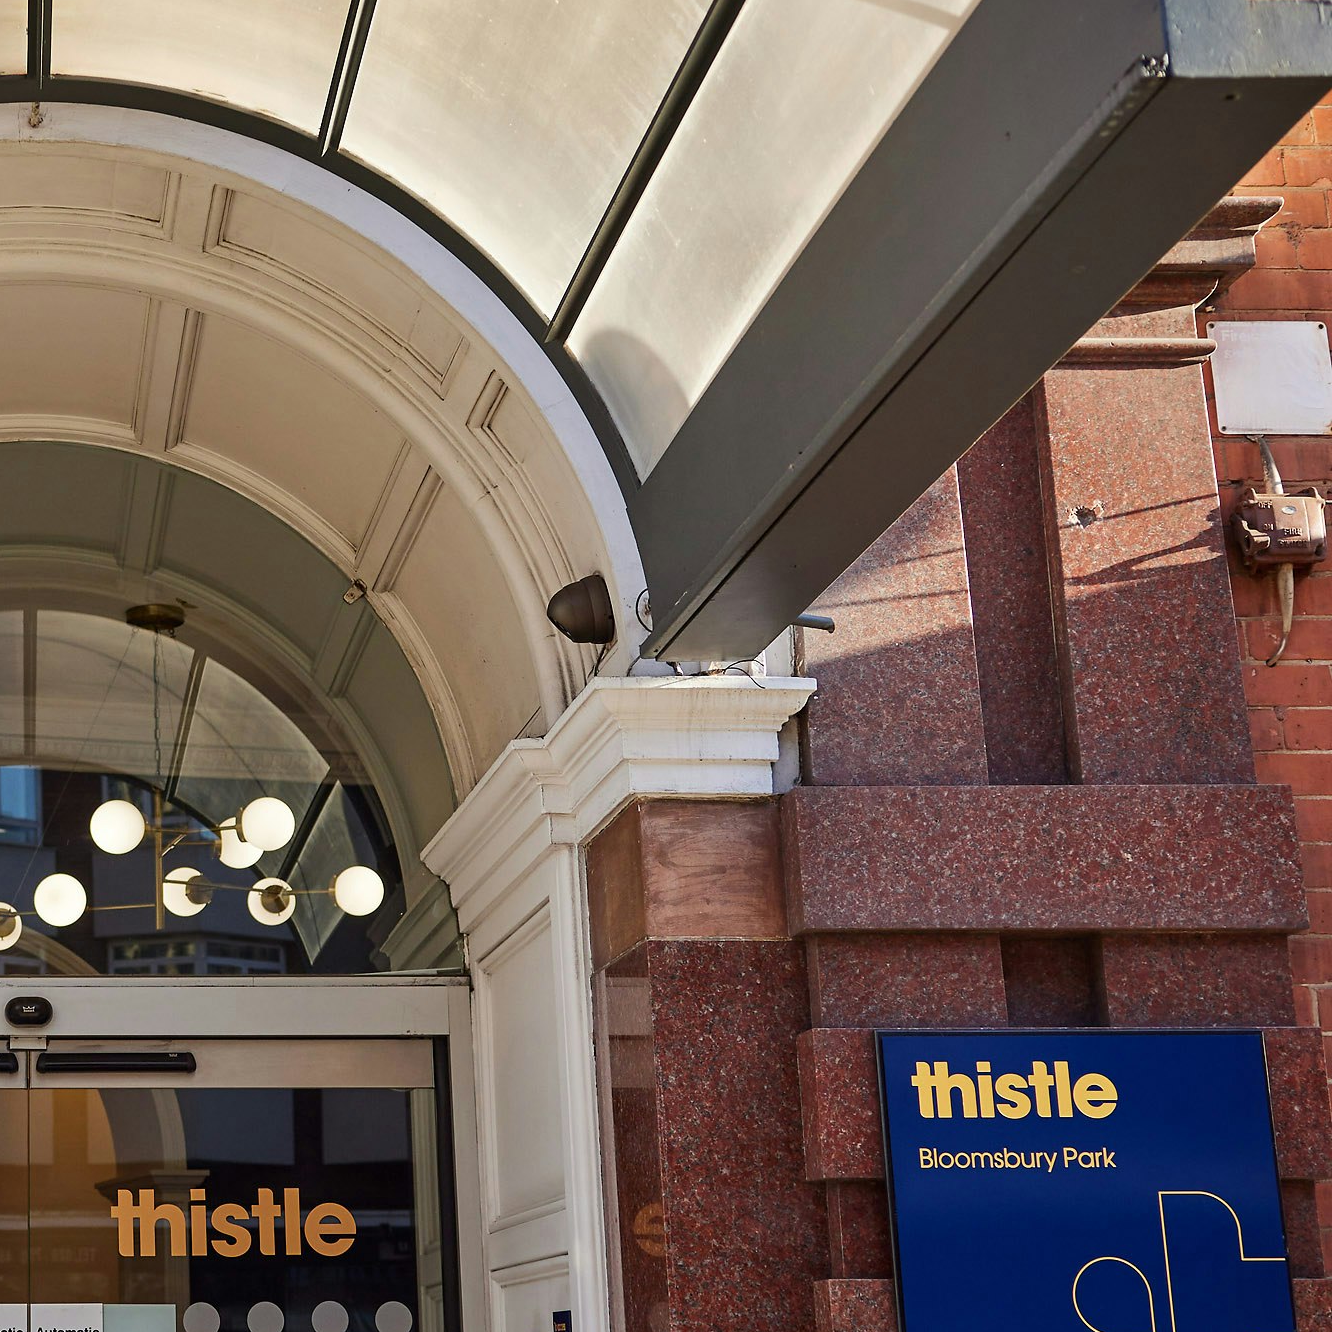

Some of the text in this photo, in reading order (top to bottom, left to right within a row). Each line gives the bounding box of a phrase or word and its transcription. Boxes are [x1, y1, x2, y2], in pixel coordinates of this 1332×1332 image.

[911, 1060, 1119, 1120] thistle
[919, 1148, 1117, 1173] Bloomsbury Park
[111, 1187, 357, 1257] thistle
